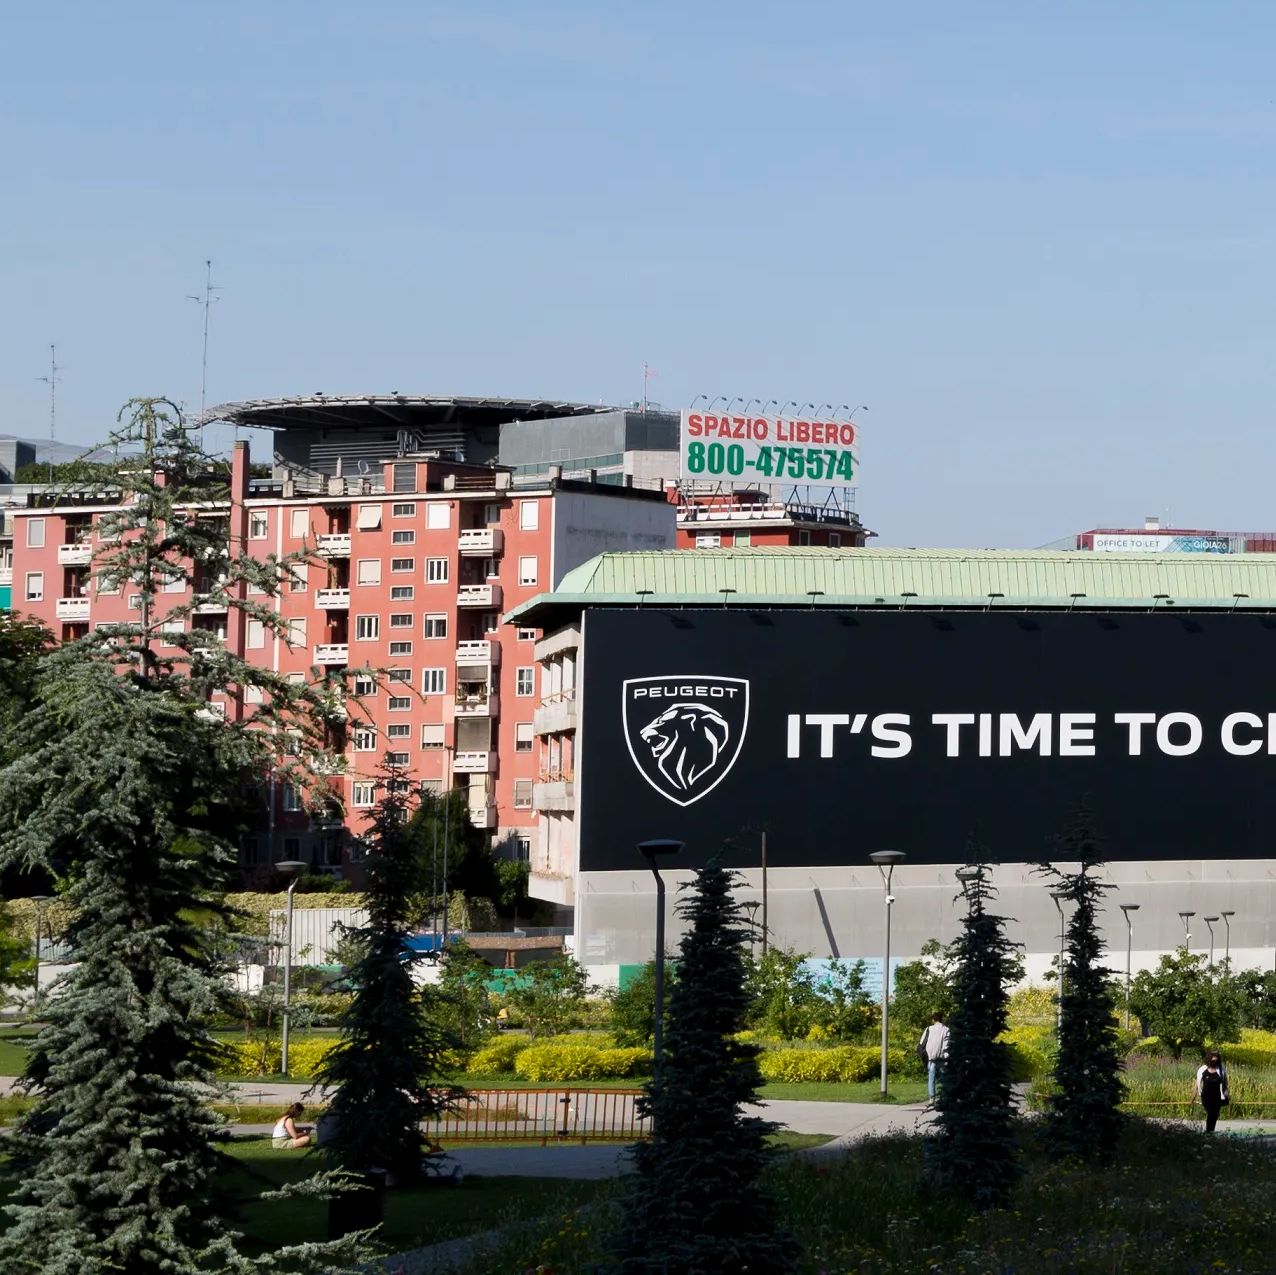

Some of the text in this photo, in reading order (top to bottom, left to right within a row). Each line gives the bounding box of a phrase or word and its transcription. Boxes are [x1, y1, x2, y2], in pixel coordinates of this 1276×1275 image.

[688, 414, 855, 445] SPAZIO LIBERO
[687, 441, 854, 481] 800-475574
[1096, 540, 1160, 548] OFFICE TO LET
[633, 686, 739, 700] PEUGEOT
[787, 713, 913, 759] IT'S
[931, 712, 1097, 757] TIME
[1114, 711, 1203, 757] TO
